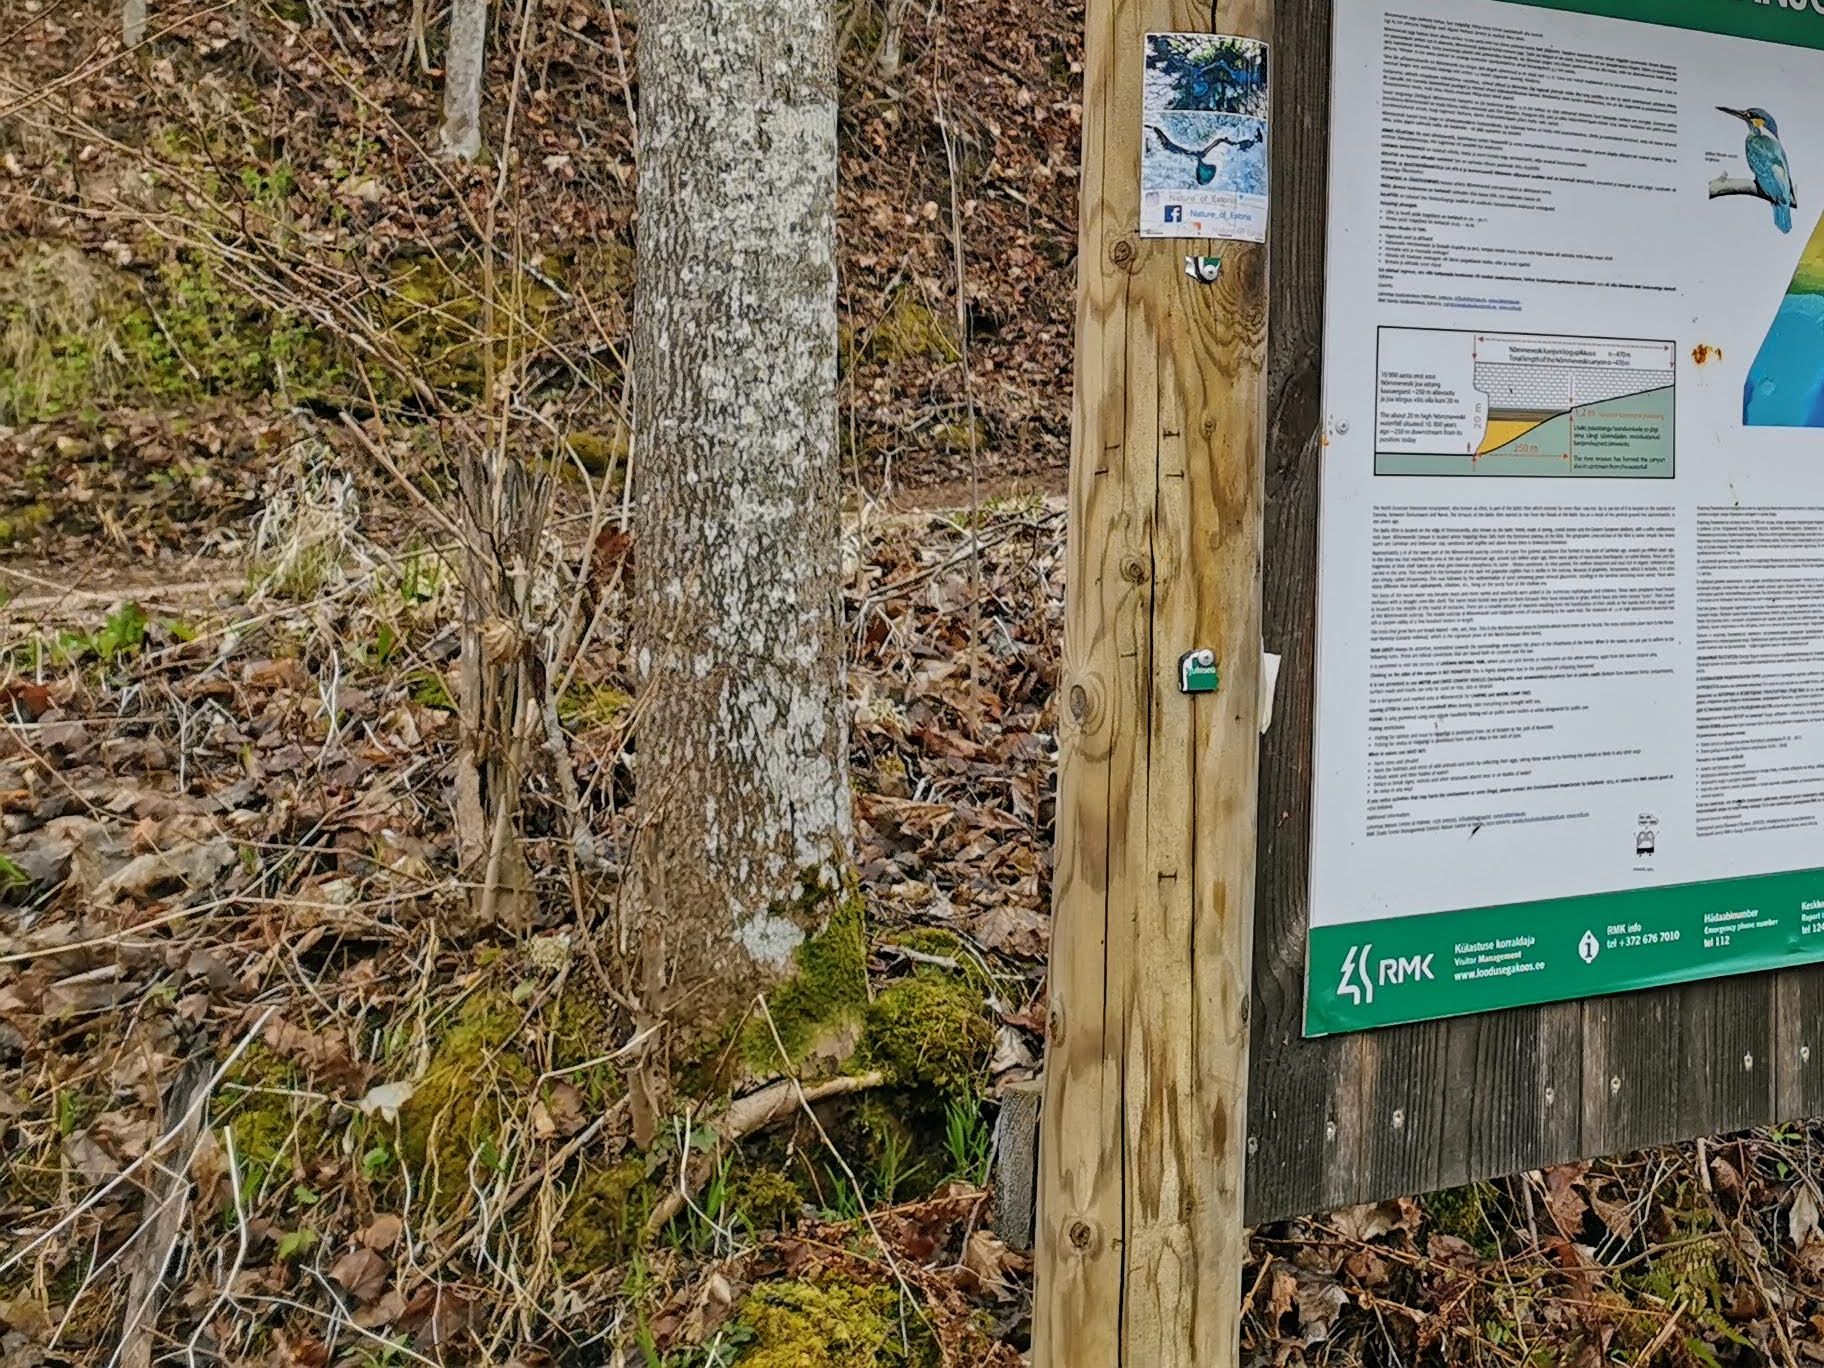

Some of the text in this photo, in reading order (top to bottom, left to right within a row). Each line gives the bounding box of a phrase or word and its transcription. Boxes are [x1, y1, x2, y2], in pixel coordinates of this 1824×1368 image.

[1703, 908, 1759, 925] Hädaabinumber
[1606, 921, 1642, 936] RMK info
[1703, 923, 1737, 936] Emergency
[1756, 917, 1779, 929] number
[1801, 924, 1812, 936] tel
[1454, 935, 1536, 955] Külastuse korraldaja
[1606, 929, 1681, 950] tel +372 676 7010
[1703, 935, 1731, 949] tel 112
[1453, 950, 1522, 967] Visitor Management
[1378, 952, 1435, 987] RMK
